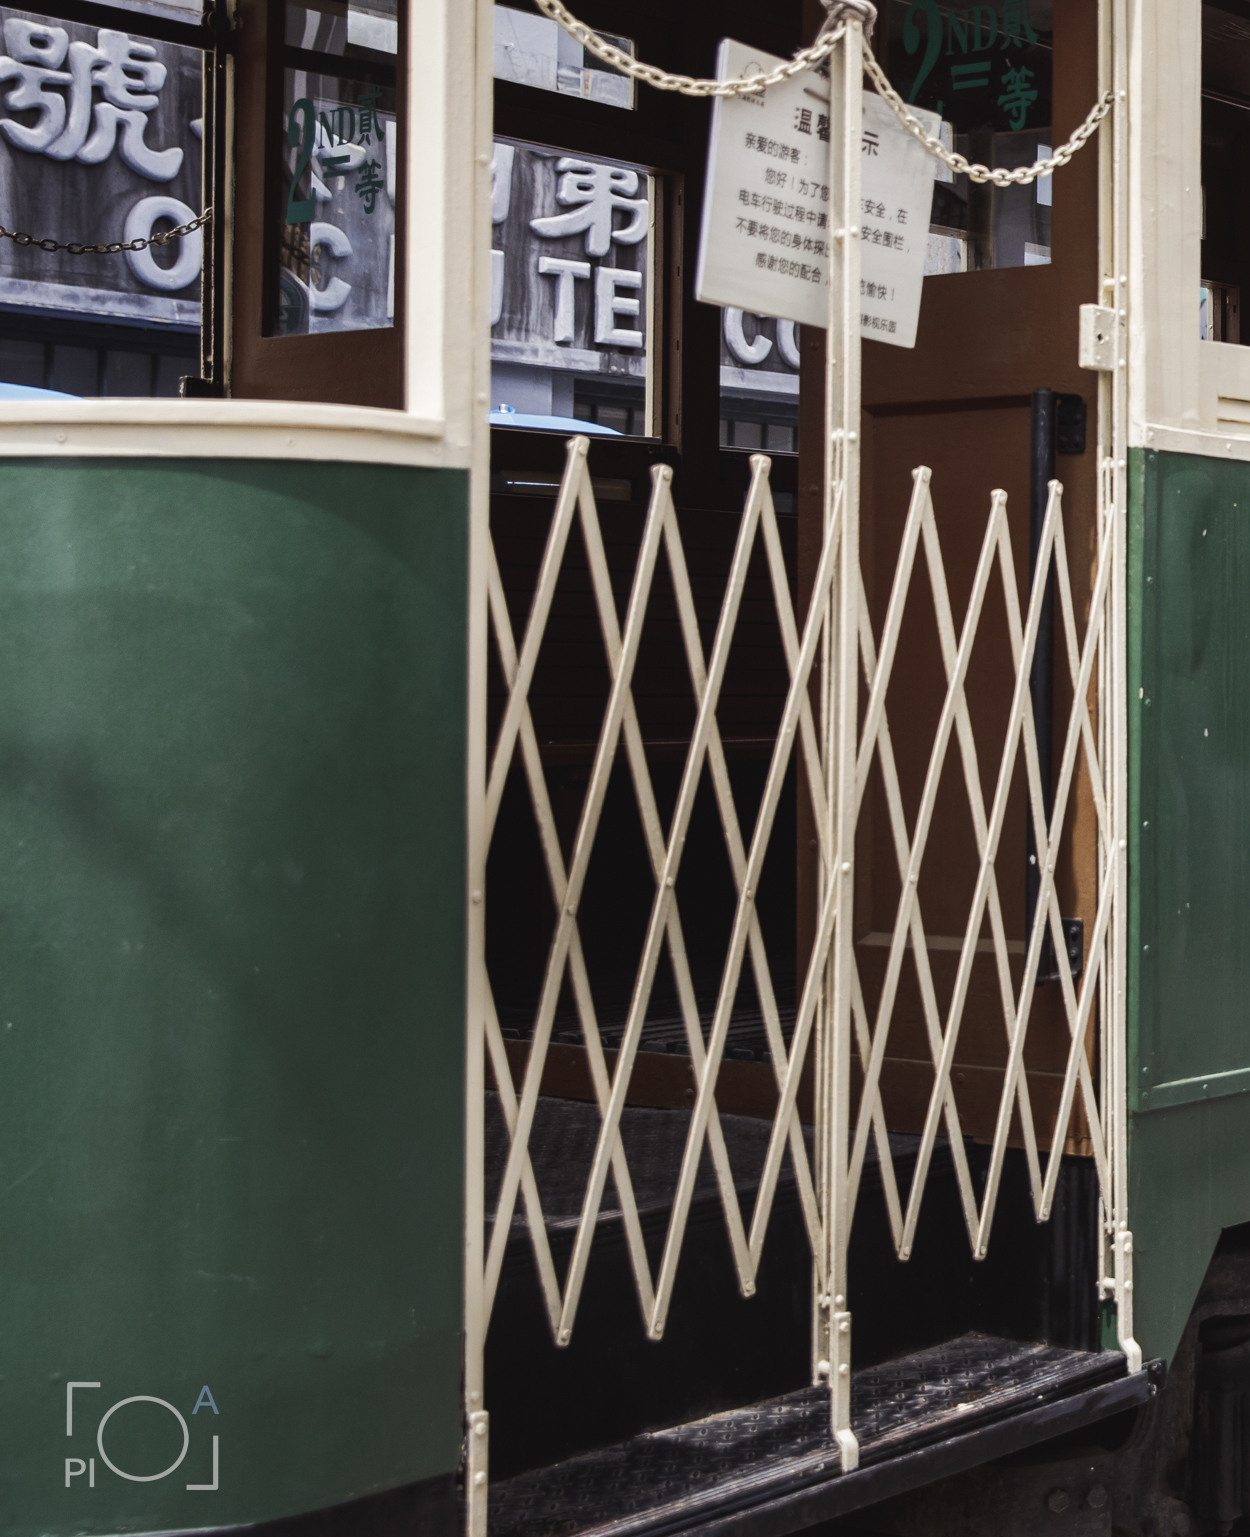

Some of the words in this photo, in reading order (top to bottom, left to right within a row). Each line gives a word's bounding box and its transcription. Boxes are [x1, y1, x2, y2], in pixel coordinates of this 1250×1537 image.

[287, 98, 356, 224] 2ND
[860, 313, 897, 334] 影视乐园
